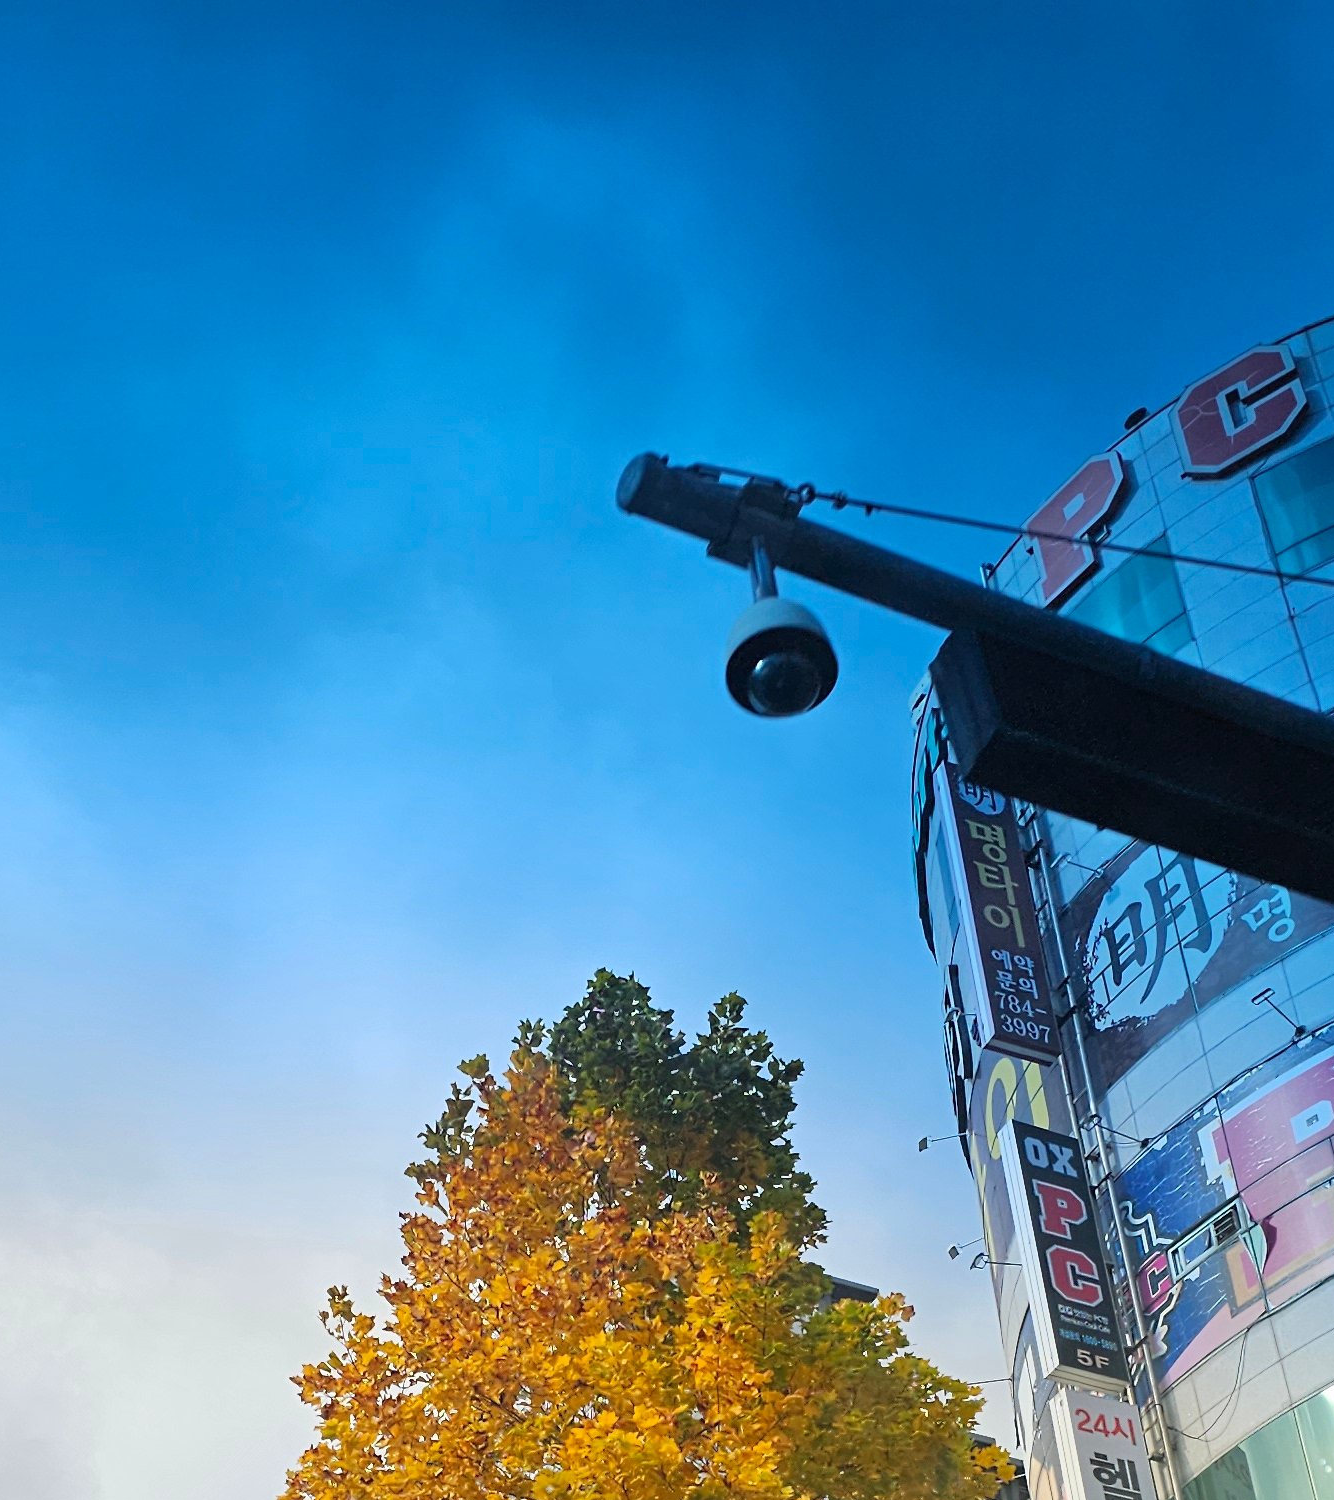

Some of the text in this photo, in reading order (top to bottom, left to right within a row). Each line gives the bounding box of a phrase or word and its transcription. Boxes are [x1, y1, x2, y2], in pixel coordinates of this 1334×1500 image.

[965, 819, 1026, 949] 명타이
[991, 950, 1035, 979] 예약
[996, 971, 1039, 1000] 문의
[994, 991, 1047, 1018] 784-
[1000, 1014, 1052, 1045] 3997
[1022, 1136, 1078, 1178] OX
[1032, 1179, 1104, 1308] PC
[1077, 1349, 1109, 1369] 5F
[1075, 1408, 1137, 1446] 24시
